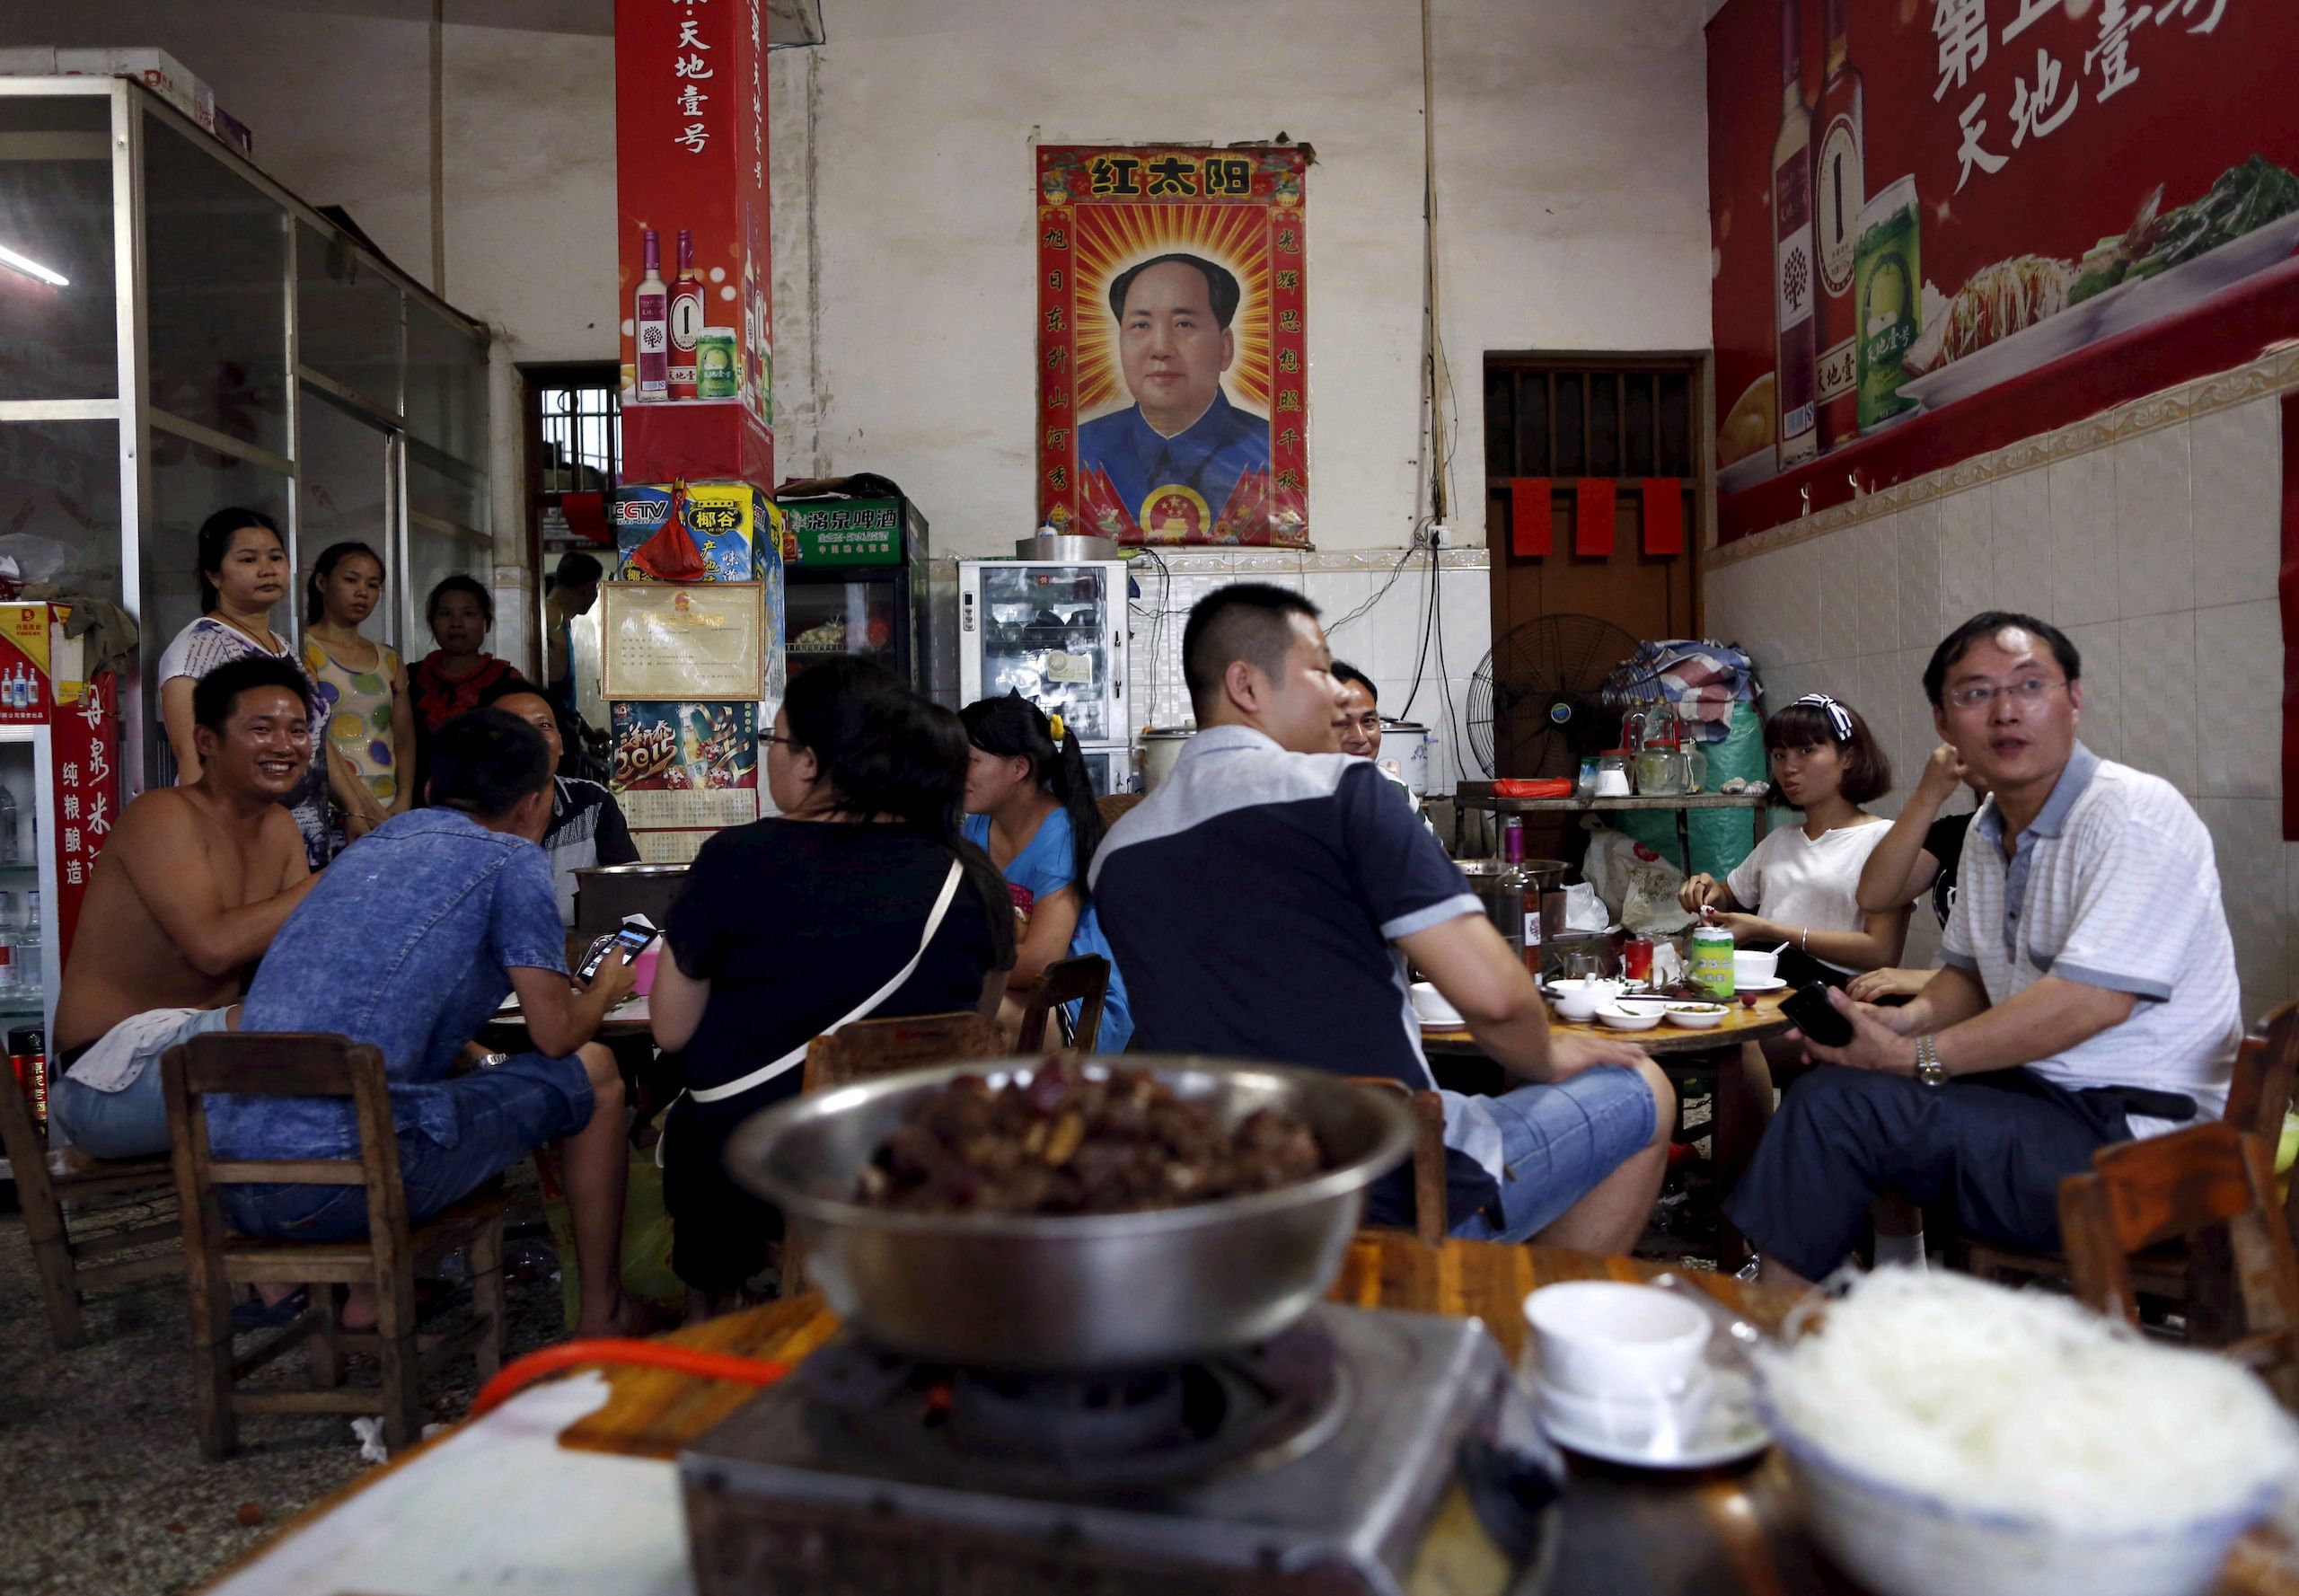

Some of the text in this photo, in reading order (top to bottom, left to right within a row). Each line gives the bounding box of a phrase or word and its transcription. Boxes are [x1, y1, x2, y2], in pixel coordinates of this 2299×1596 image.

[674, 0, 713, 154] ·天地壹号
[1090, 158, 1252, 196] 红太阳
[1043, 226, 1069, 490] 旭日东升山河秀
[1277, 227, 1304, 491] 光辉思想照千秋
[696, 510, 736, 528] 椰谷
[808, 509, 898, 531] 漓泉啤酒
[63, 762, 83, 885] 纯粮酿造
[77, 684, 111, 877] 丹泉米
